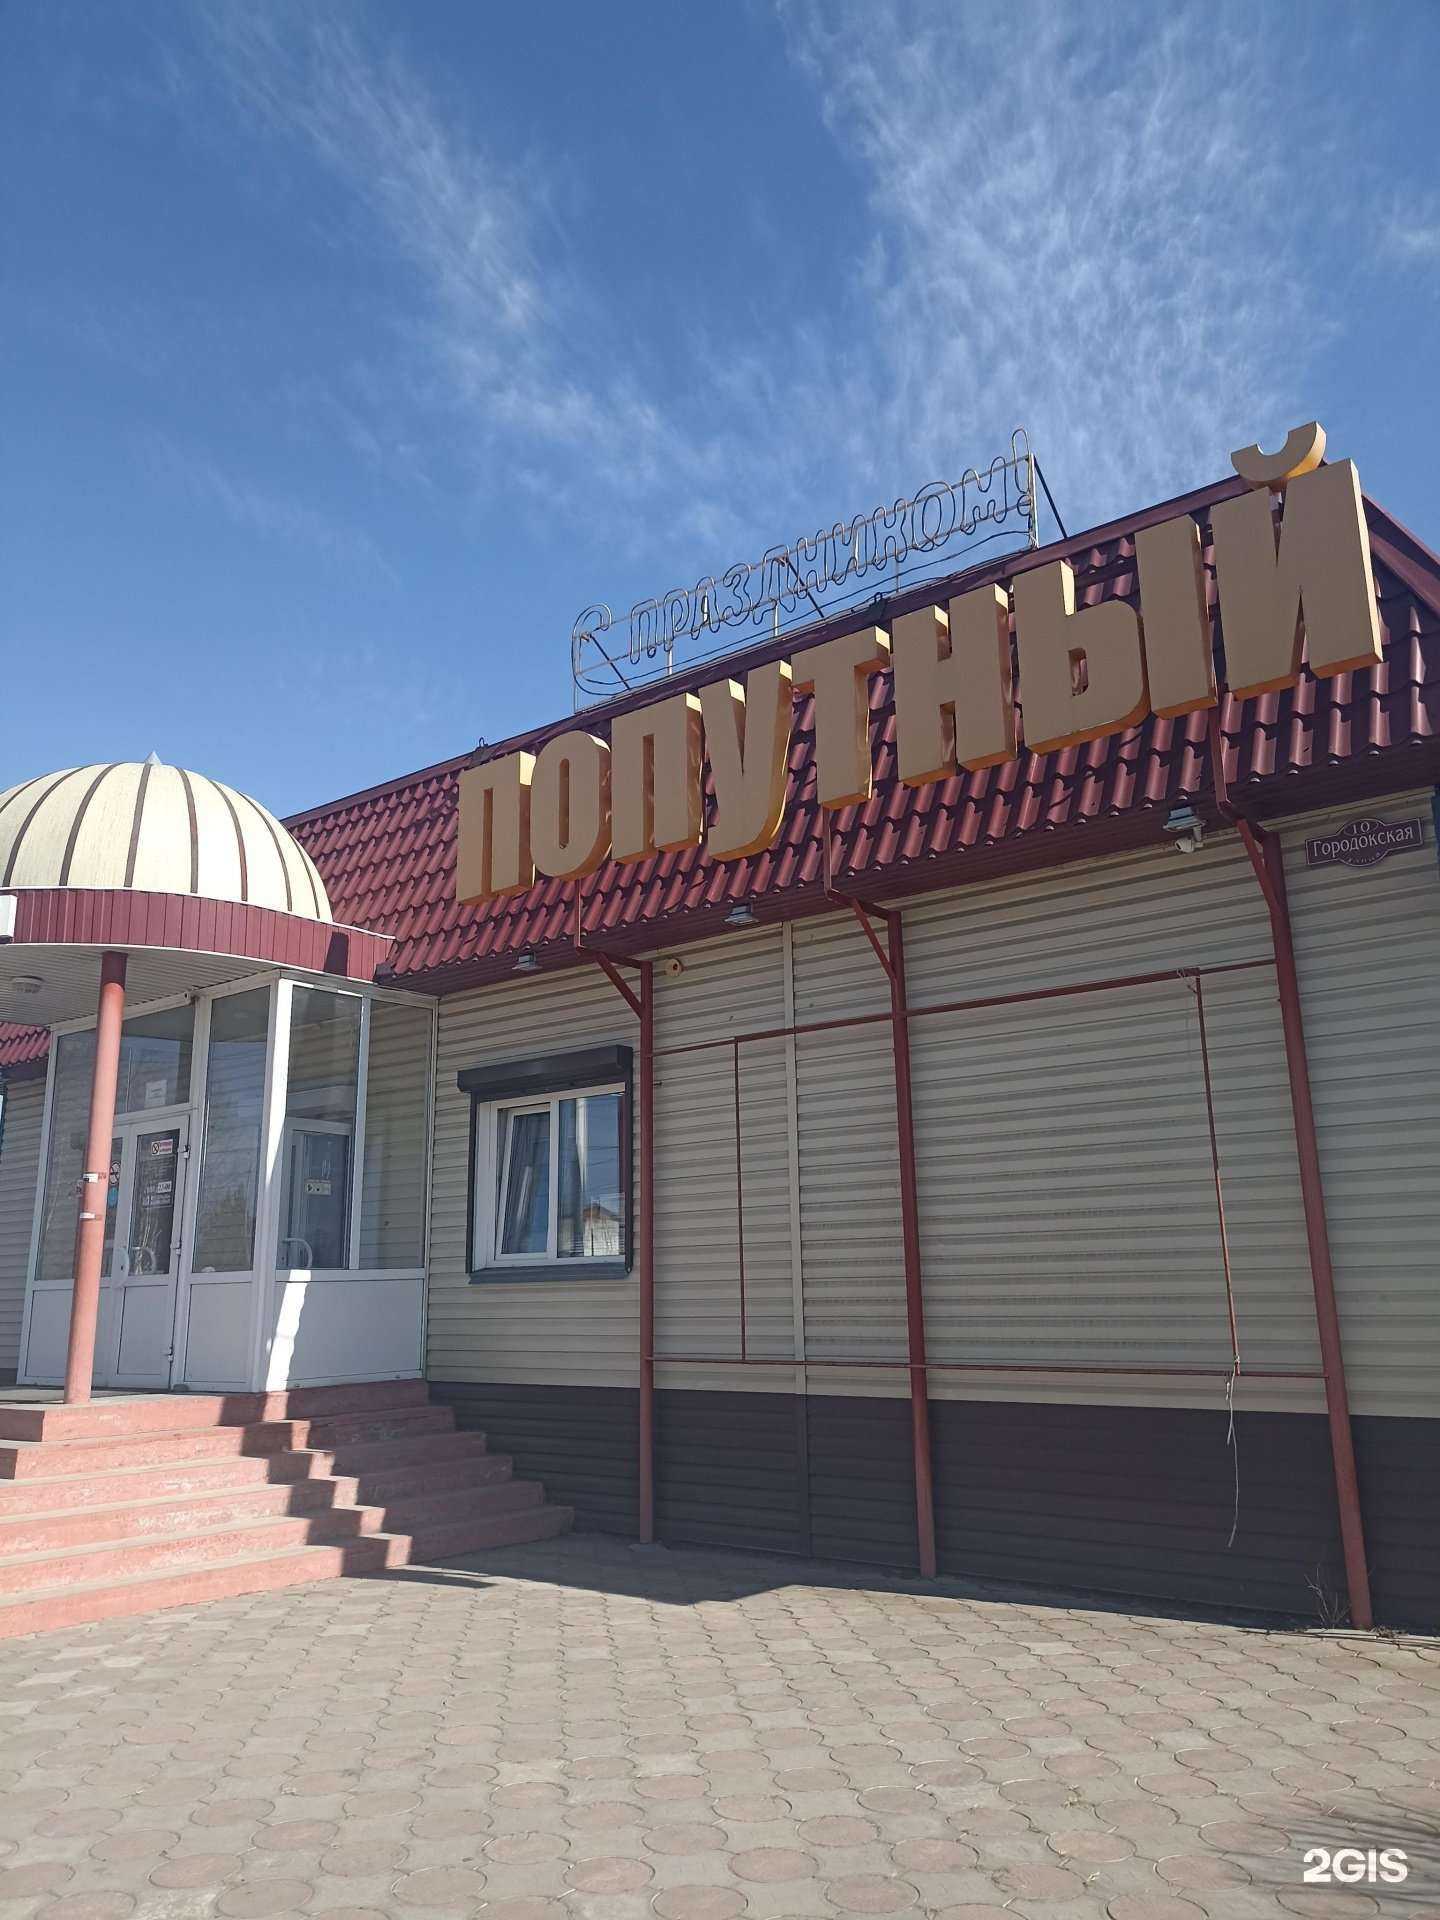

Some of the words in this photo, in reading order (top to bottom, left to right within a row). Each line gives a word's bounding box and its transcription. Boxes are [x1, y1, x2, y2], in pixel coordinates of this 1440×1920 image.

[571, 603, 613, 696] С
[629, 427, 1031, 665] ПРАЗДНИКОМ!
[455, 421, 1384, 906] ПОПУТНЫЙ
[1313, 826, 1413, 858] Городокская
[1352, 821, 1371, 834] 10
